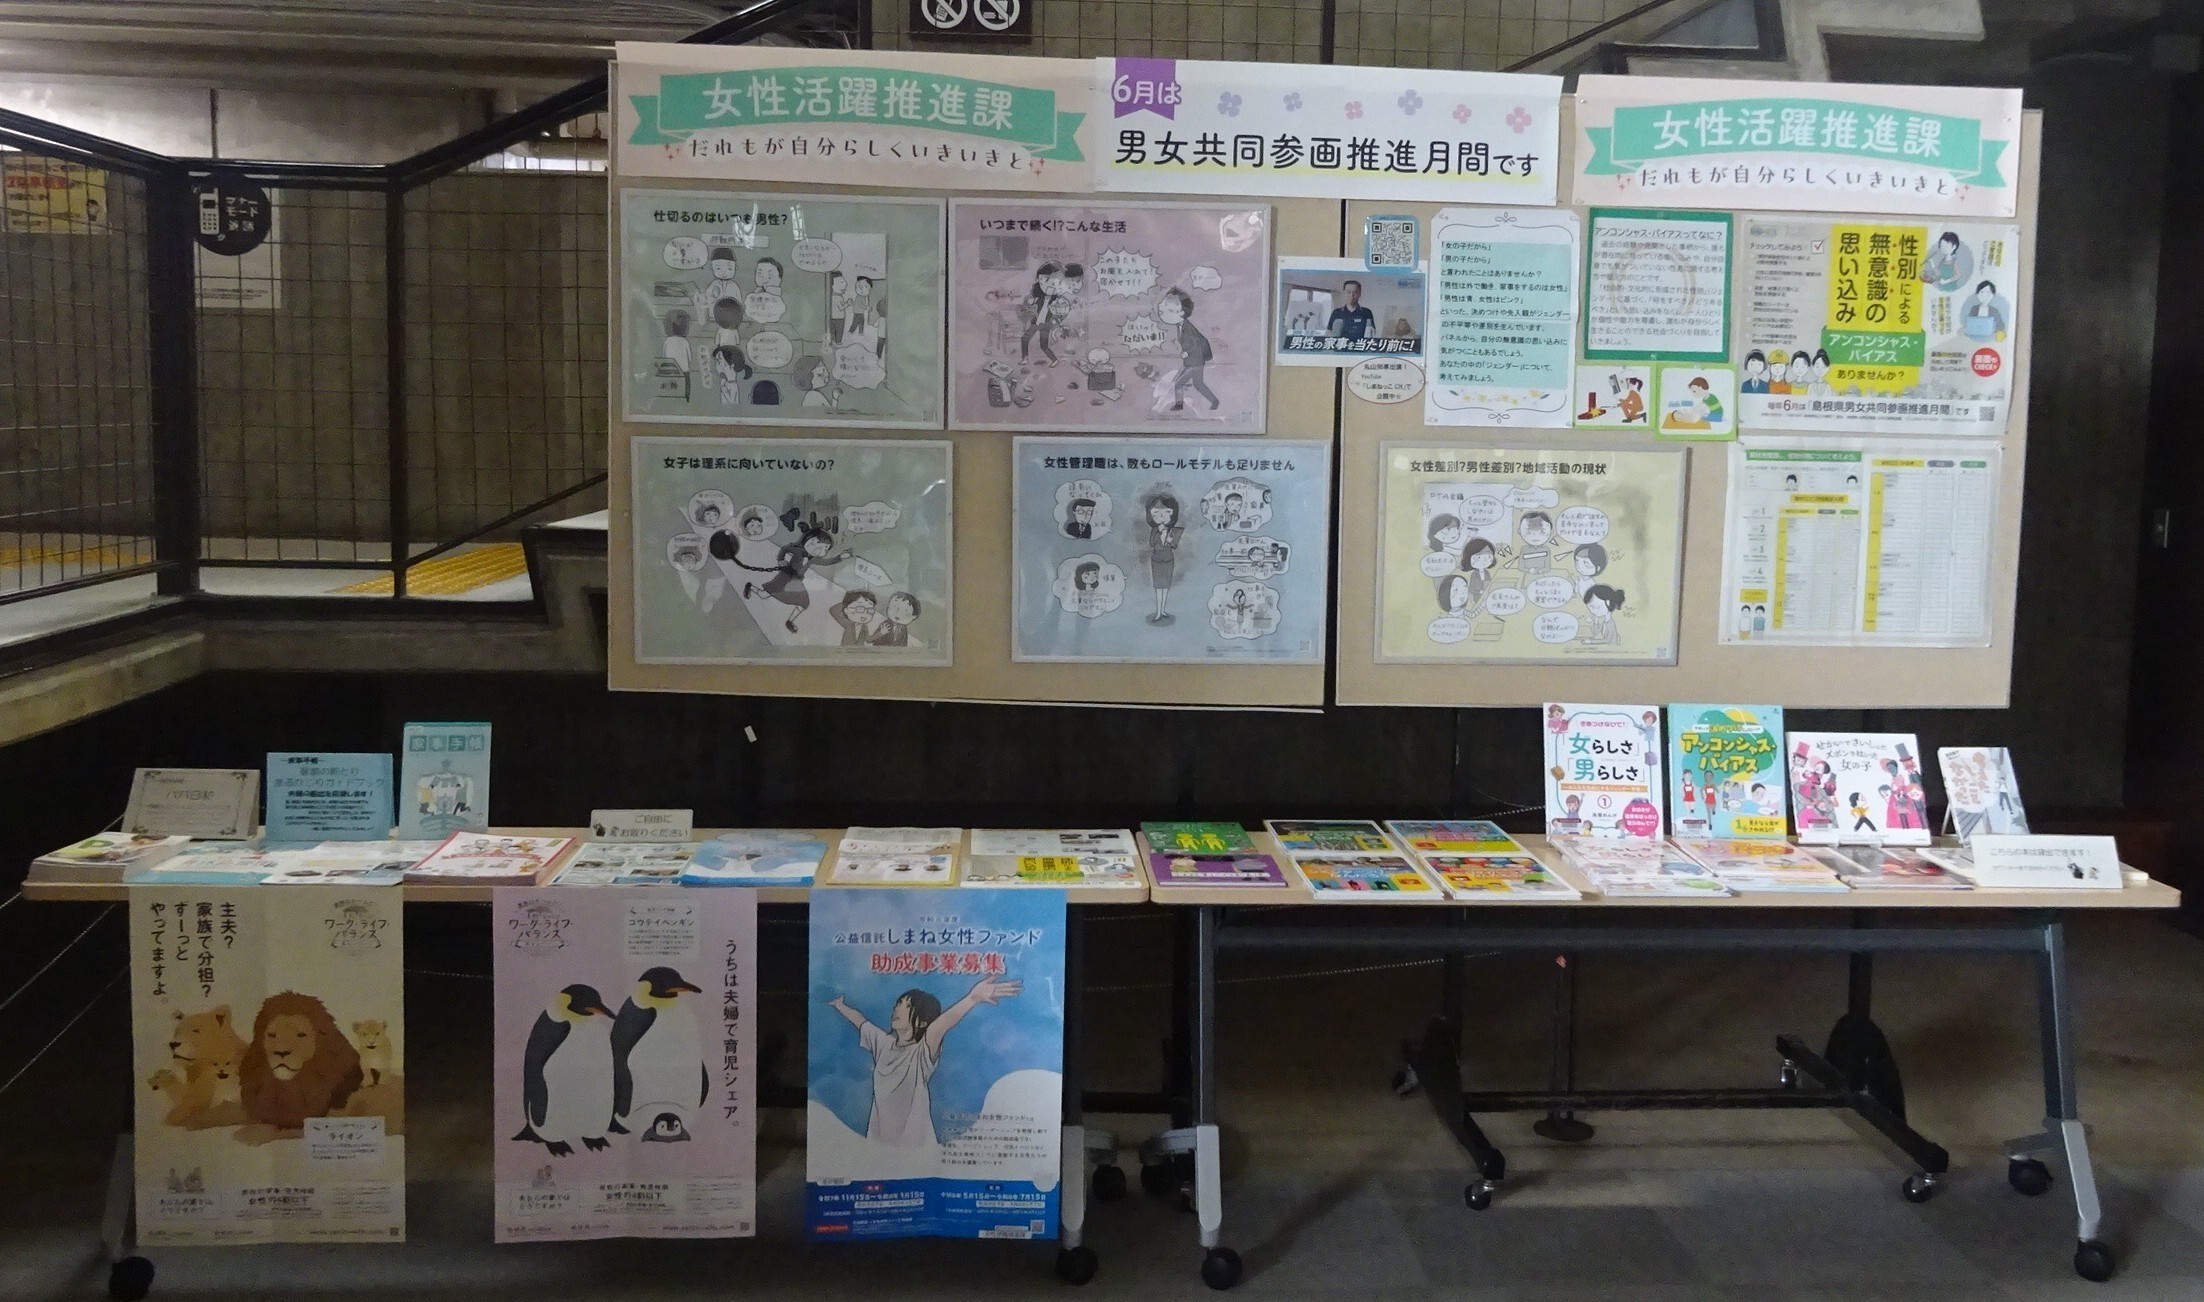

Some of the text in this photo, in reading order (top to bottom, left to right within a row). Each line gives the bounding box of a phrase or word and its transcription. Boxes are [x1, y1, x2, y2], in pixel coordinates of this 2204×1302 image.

[702, 75, 1013, 131] 女性活躍推進課
[1112, 74, 1182, 106] 6月は
[1653, 106, 1942, 158] 女性活躍推進課
[689, 135, 1022, 170] だれもが自分らしくいきいきと
[1115, 129, 1539, 178] 男女共同参画推進月間です
[1639, 166, 1952, 197] だれもが自分らしくいきいきと
[1836, 231, 1860, 323] 思い込み
[1866, 232, 1891, 323] 無意識の
[1896, 234, 1919, 324] 性別による
[1848, 349, 1897, 362] バイアス
[663, 456, 835, 471] 女子は理系に向いていないの?
[1044, 456, 1295, 472] 女性管理職は、数もロールモデルも足りません
[1410, 461, 1607, 476] 女性差別?男性差別?地域活動の現状
[1562, 732, 1640, 756] 「女らしさ」
[1567, 757, 1646, 782] 「男らしさ」
[1699, 754, 1760, 774] バイアス
[1838, 758, 1873, 772] 女の子
[174, 902, 189, 962] ずーっと
[834, 927, 1041, 946] 公益信託しまね女性ファンド
[871, 951, 1007, 974] 助成事業募集
[723, 938, 740, 1128] うちは夫婦で育児シェア。
